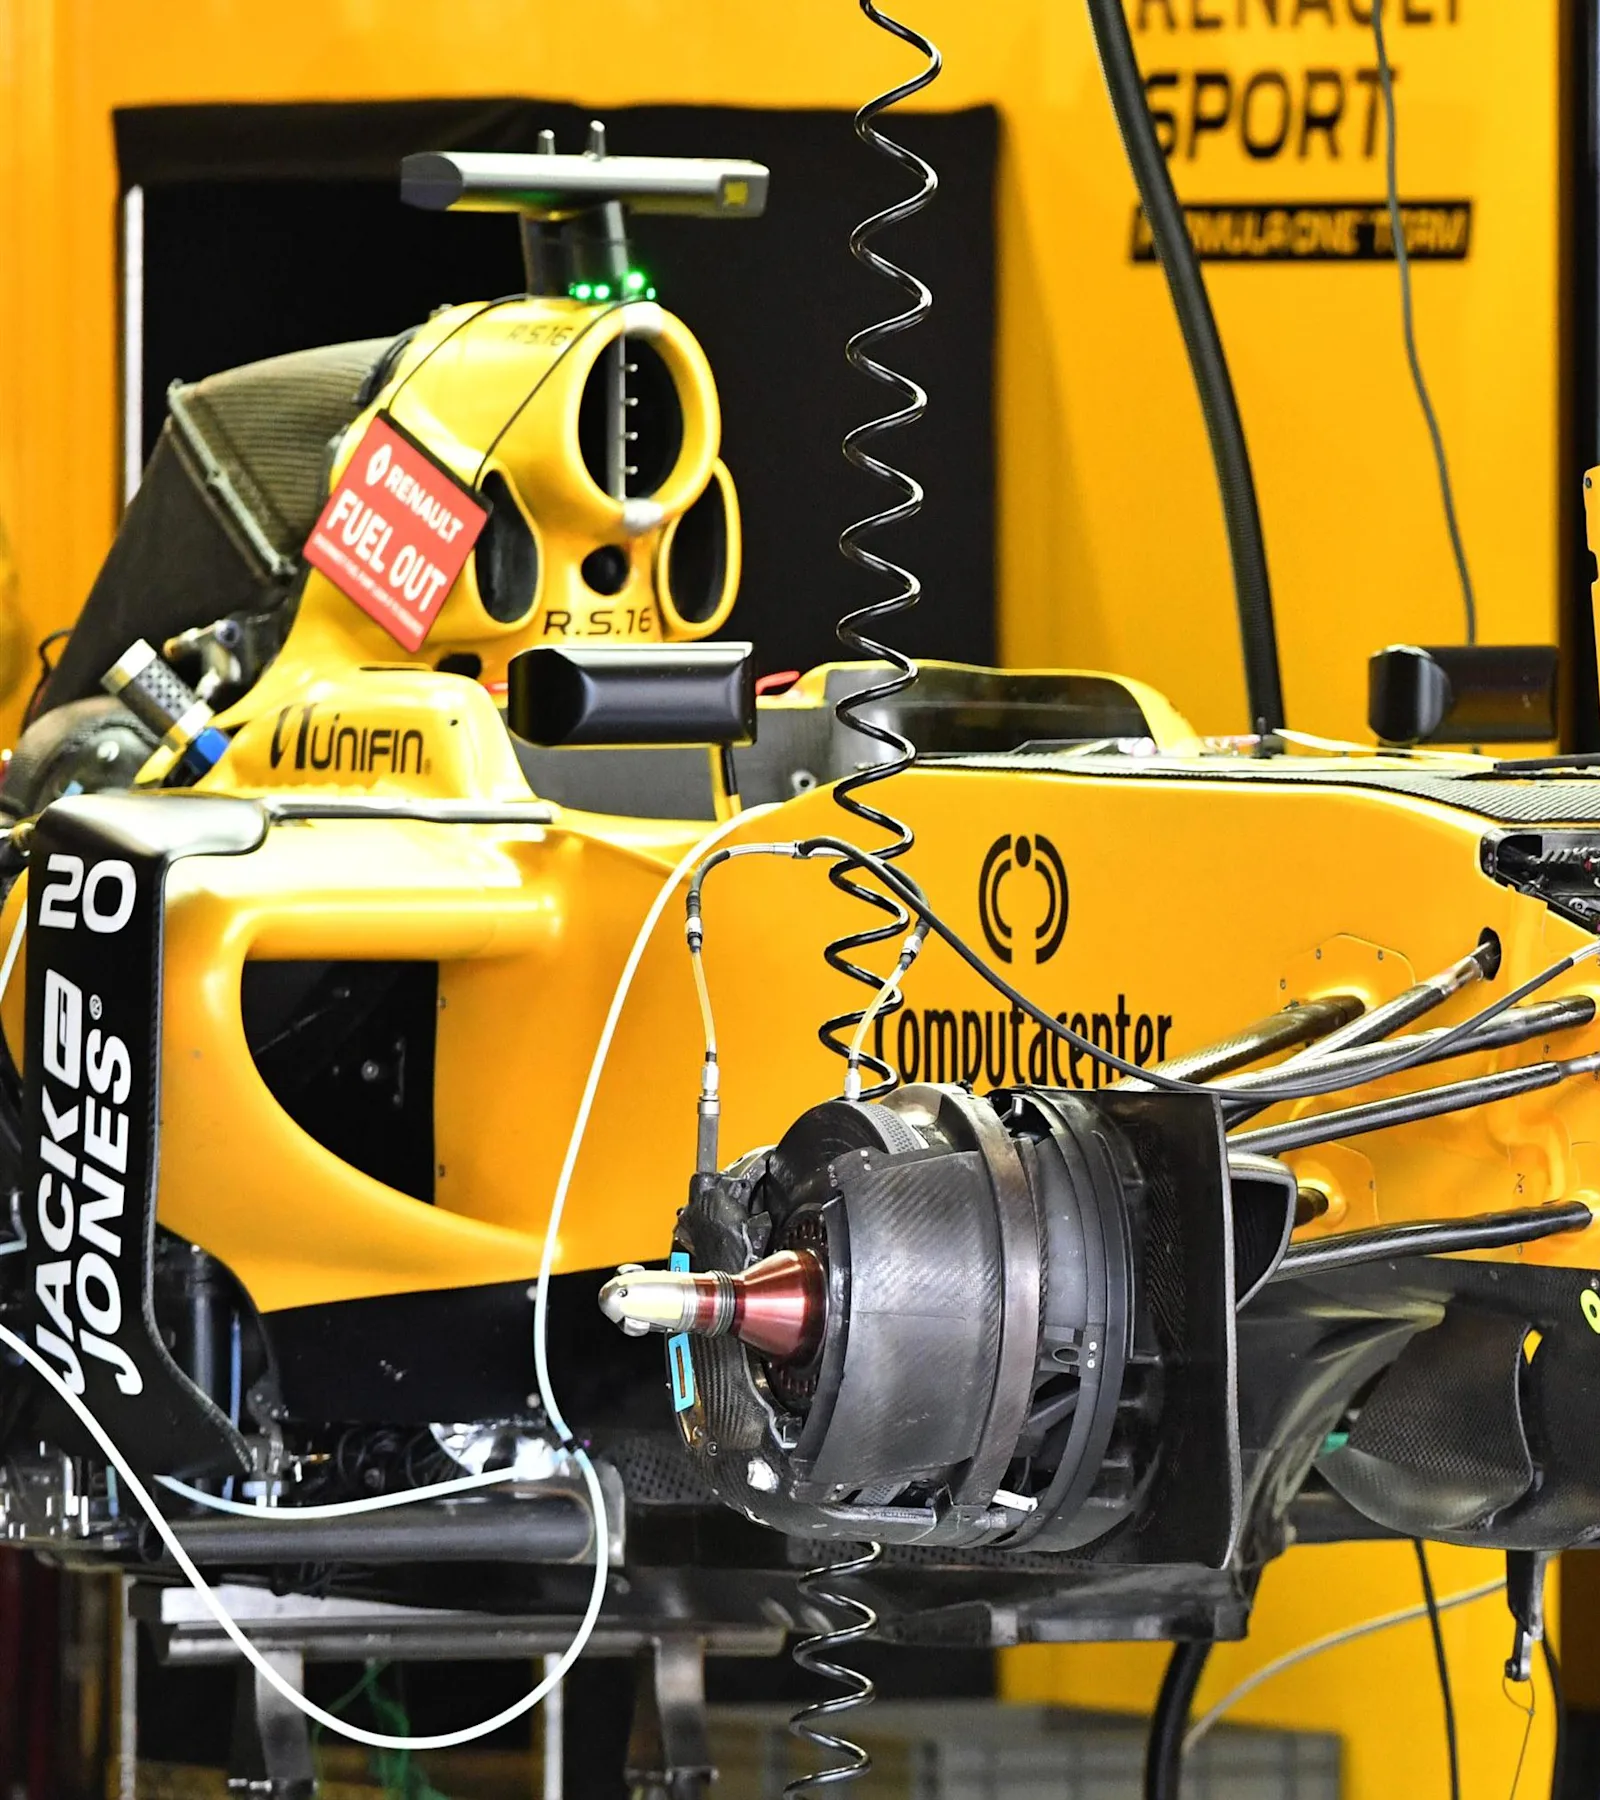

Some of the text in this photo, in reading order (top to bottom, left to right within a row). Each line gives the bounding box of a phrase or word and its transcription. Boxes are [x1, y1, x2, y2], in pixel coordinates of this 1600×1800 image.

[1143, 69, 1398, 161] SPORT
[384, 464, 464, 544] RENAULT
[326, 488, 394, 574] FUEL
[389, 545, 447, 612] OUT
[543, 606, 652, 636] R.S.16
[38, 853, 138, 934] 20
[35, 1085, 86, 1396] JACK
